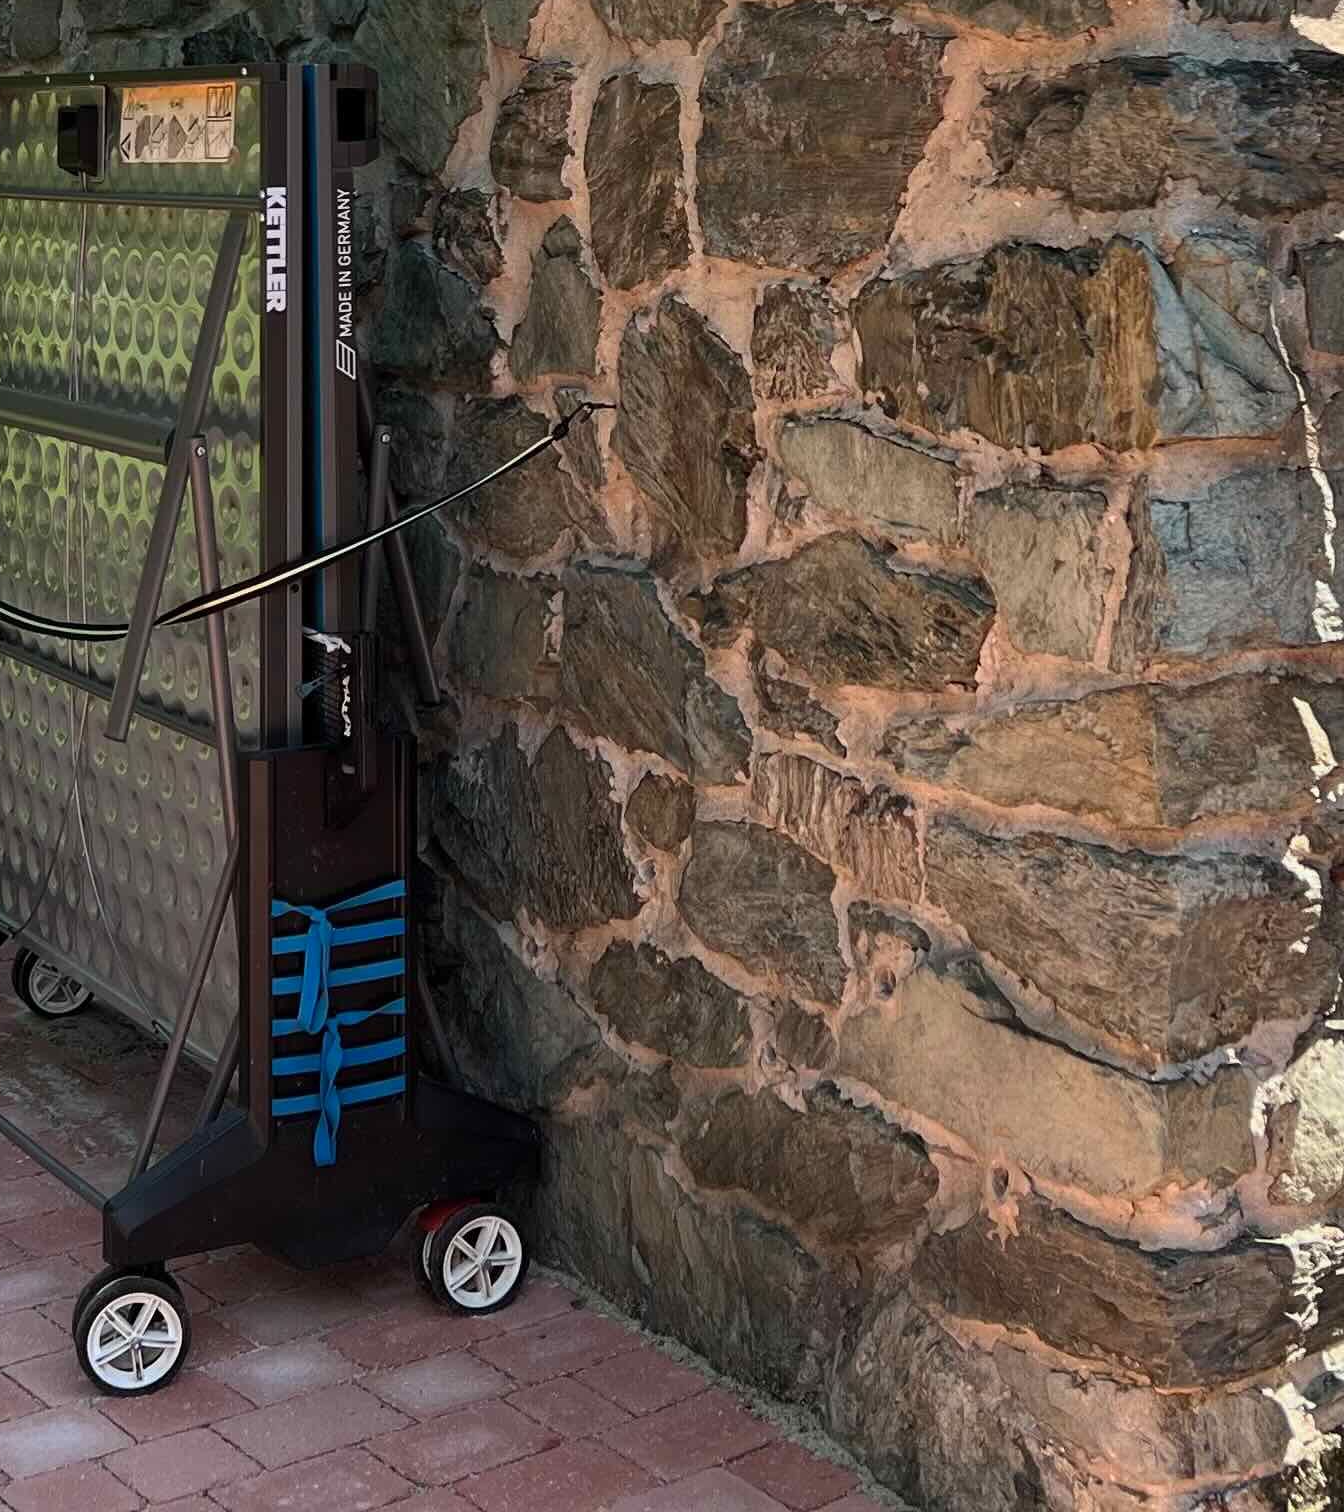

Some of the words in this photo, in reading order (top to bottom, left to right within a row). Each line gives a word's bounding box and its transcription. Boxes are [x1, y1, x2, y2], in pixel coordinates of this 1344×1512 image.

[266, 187, 287, 313] KETTLER
[337, 188, 352, 267] GERMANY
[339, 271, 352, 288] IN
[338, 291, 353, 337] MADE
